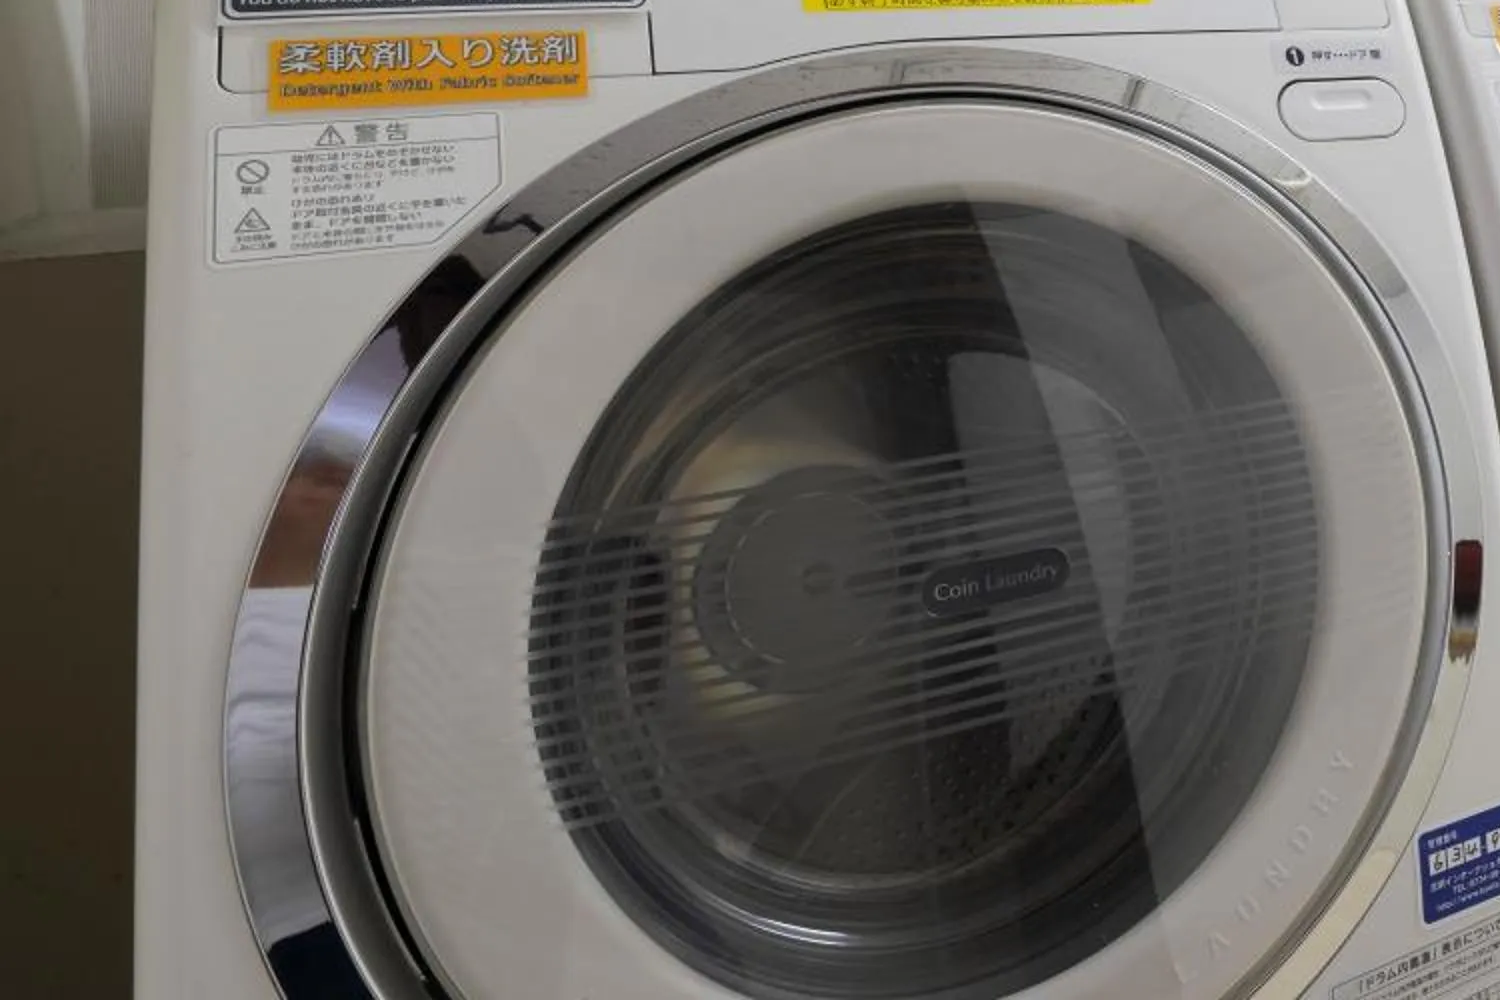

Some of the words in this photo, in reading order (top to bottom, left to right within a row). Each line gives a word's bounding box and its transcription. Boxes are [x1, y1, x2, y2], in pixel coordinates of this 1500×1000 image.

[280, 34, 580, 75] 柔軟剤入り洗剤
[353, 123, 409, 144] 警告
[933, 579, 980, 601] Coin
[985, 562, 1058, 592] Laundry
